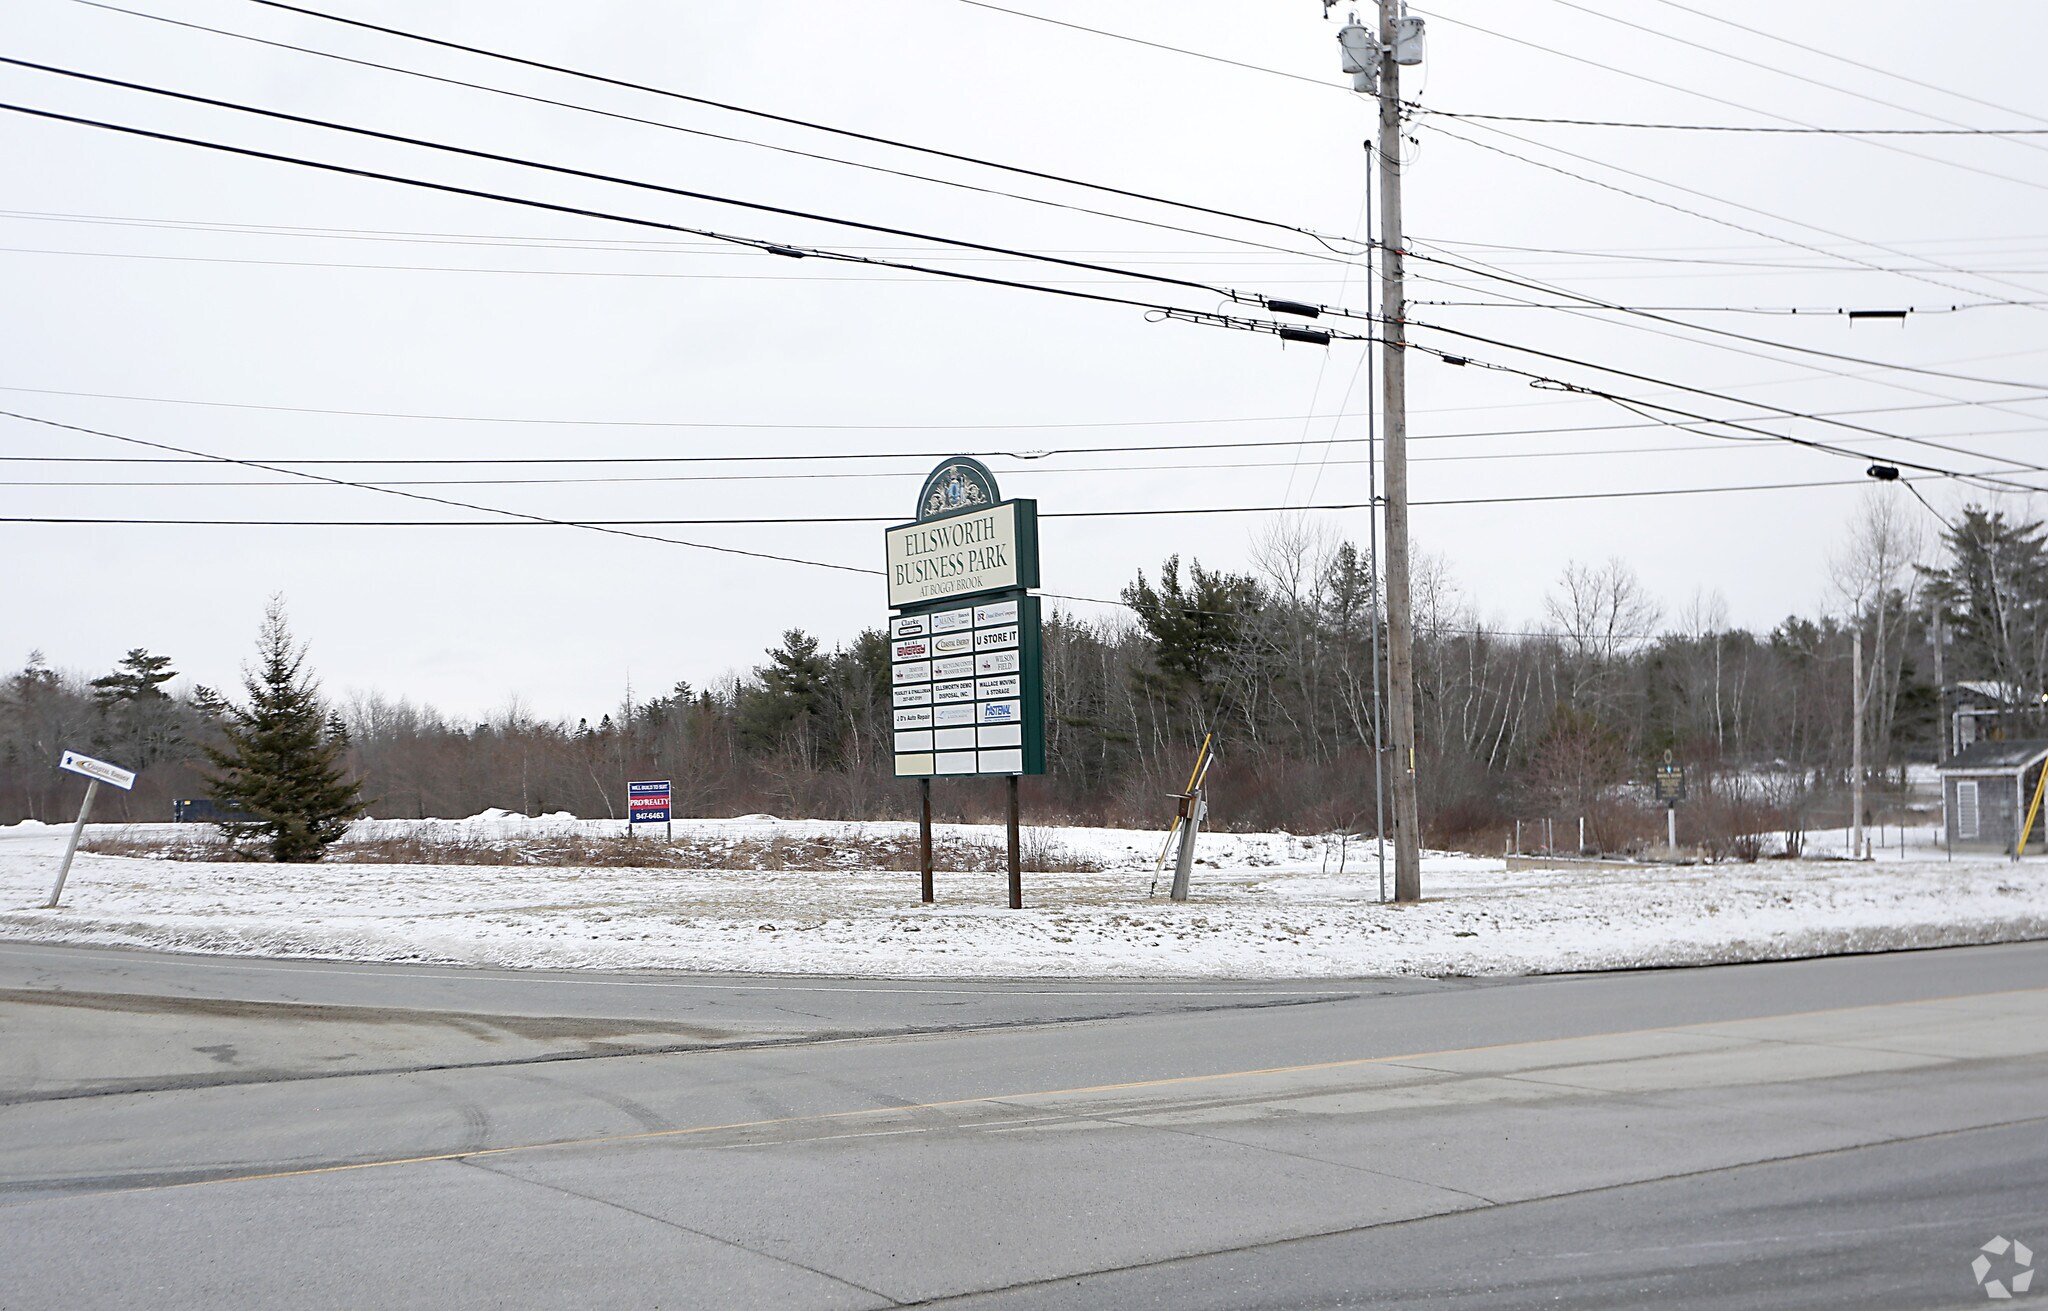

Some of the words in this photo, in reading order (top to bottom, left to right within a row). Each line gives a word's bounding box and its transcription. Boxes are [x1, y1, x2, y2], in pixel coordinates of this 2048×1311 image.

[905, 517, 995, 556] ELLSWORTH
[896, 552, 964, 586] BUSINESS
[968, 543, 1008, 572] PARK
[920, 586, 930, 597] AT
[930, 580, 956, 595] BOGGY
[956, 575, 984, 591] BROOK
[976, 636, 982, 645] U
[983, 632, 1008, 645] STORE
[1009, 630, 1017, 641] IT
[995, 654, 1014, 663] WILSON
[997, 662, 1012, 671] FIELD
[979, 680, 998, 688] WALLACE
[999, 678, 1016, 686] MOVING
[990, 687, 1010, 695] STORAGE
